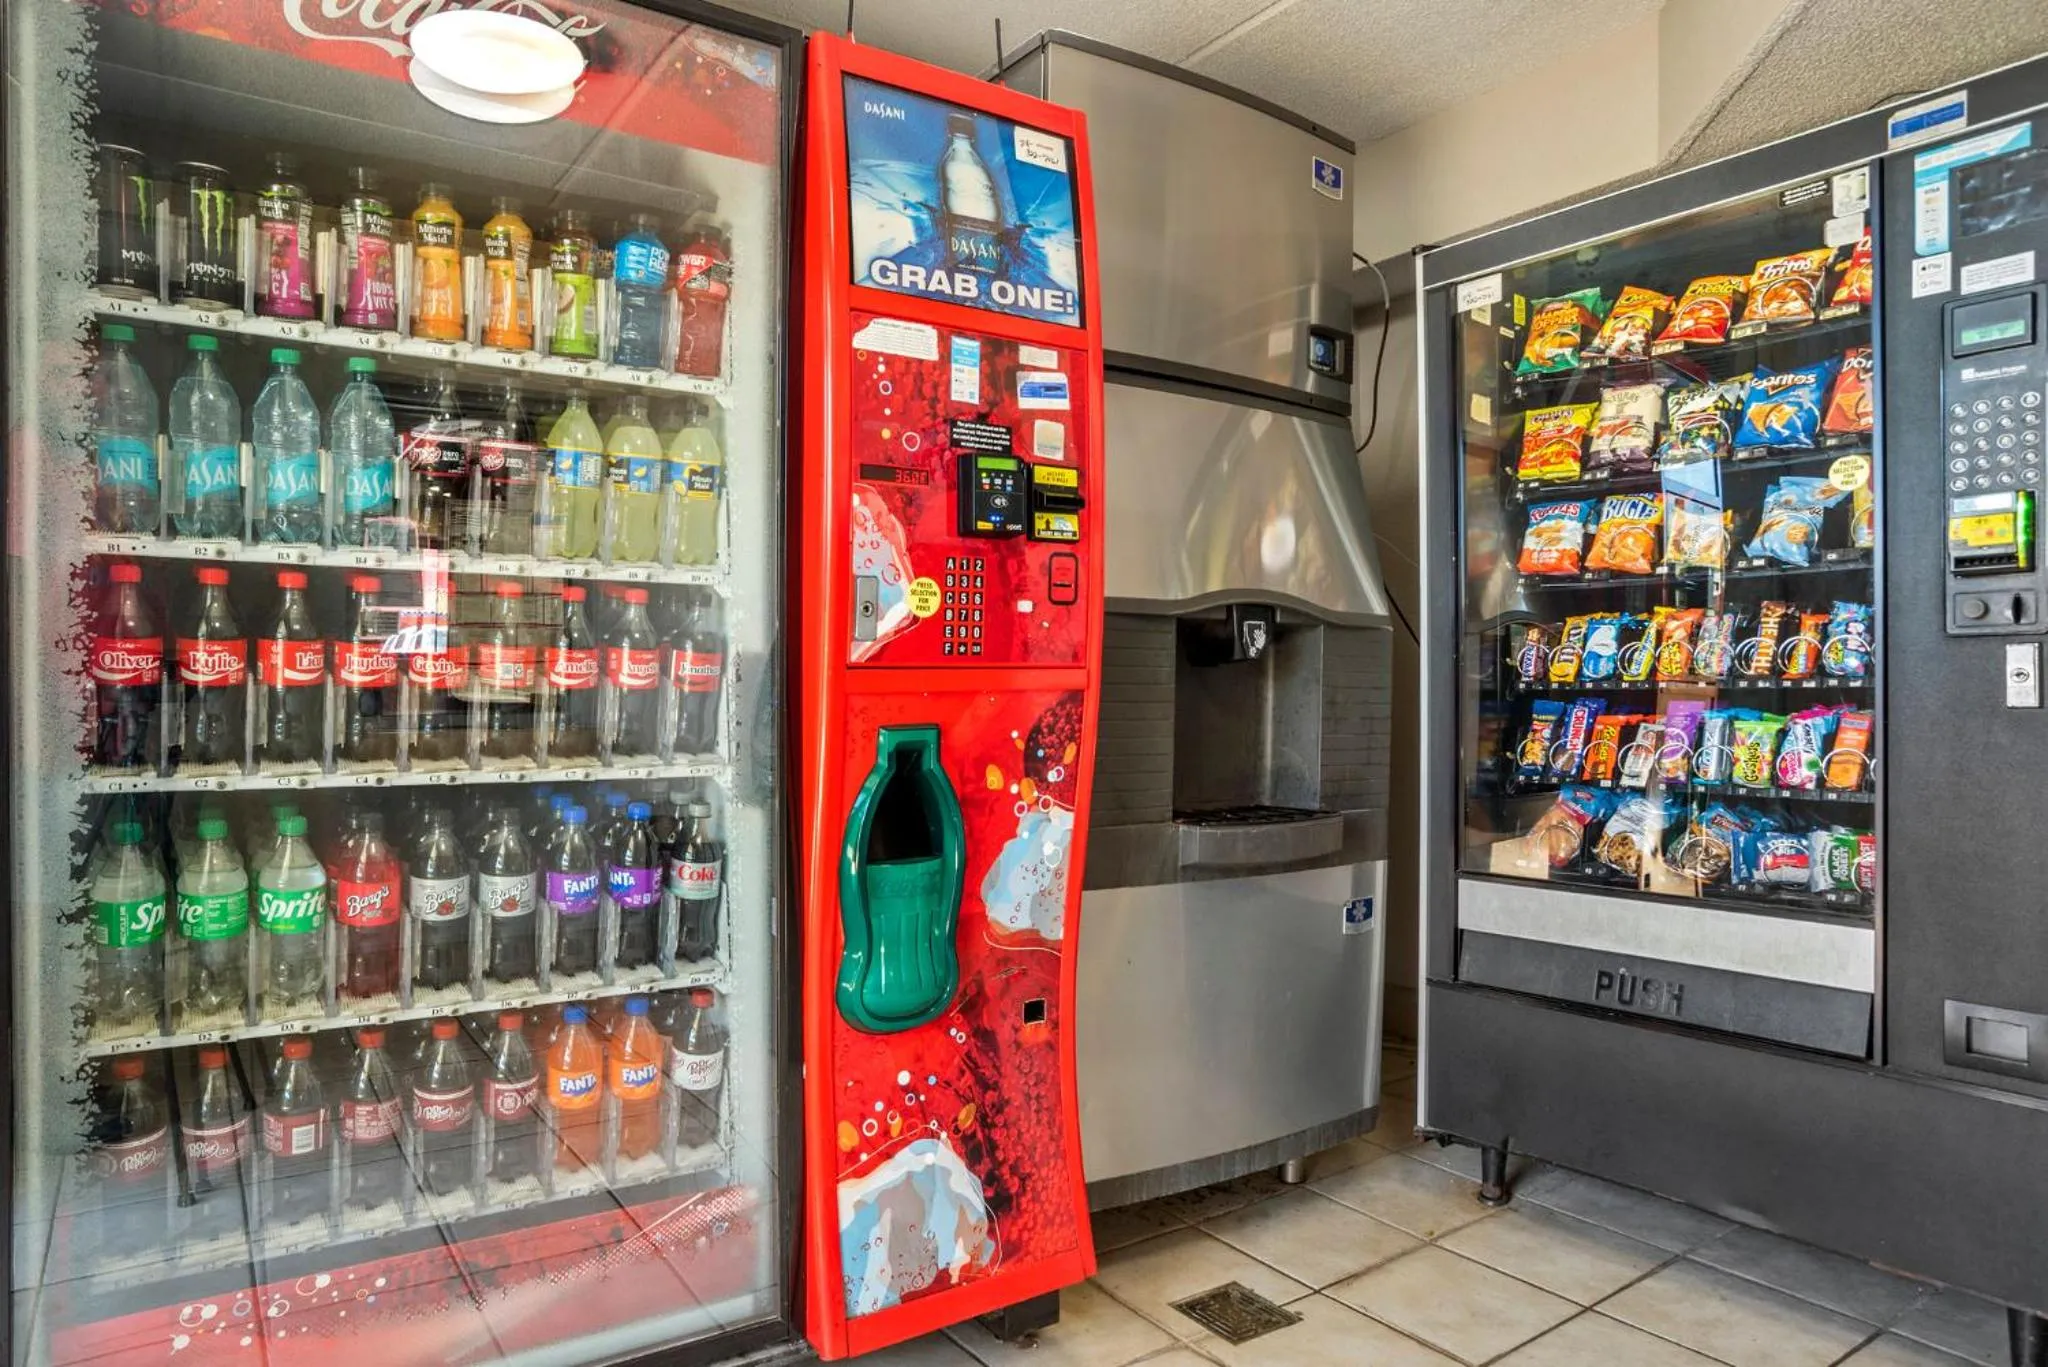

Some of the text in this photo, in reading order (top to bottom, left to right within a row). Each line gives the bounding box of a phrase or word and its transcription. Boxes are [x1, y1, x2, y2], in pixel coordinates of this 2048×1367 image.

[864, 101, 906, 121] DASANI
[951, 236, 1001, 261] DASANI
[1760, 257, 1814, 281] Fritos
[870, 258, 1075, 314] GRAB ONE!
[103, 457, 142, 480] ANI
[187, 458, 238, 491] ASAN
[266, 463, 318, 498] DASAN
[346, 470, 393, 503] DASA
[947, 558, 982, 571] A 1 2
[946, 574, 982, 588] B 3 4
[946, 592, 981, 604] C 5 6
[960, 609, 966, 620] 7
[974, 610, 980, 621] 8
[945, 626, 980, 638] E 9 0
[100, 651, 153, 669] Oliver
[944, 643, 951, 654] F
[189, 651, 238, 674] Kylie
[1570, 709, 1586, 751] CRUNCH
[609, 871, 635, 888] ANTA
[677, 864, 717, 882] Coke
[177, 895, 204, 924] ite
[346, 884, 390, 918] Barq's
[1593, 969, 1685, 1017] PUSH
